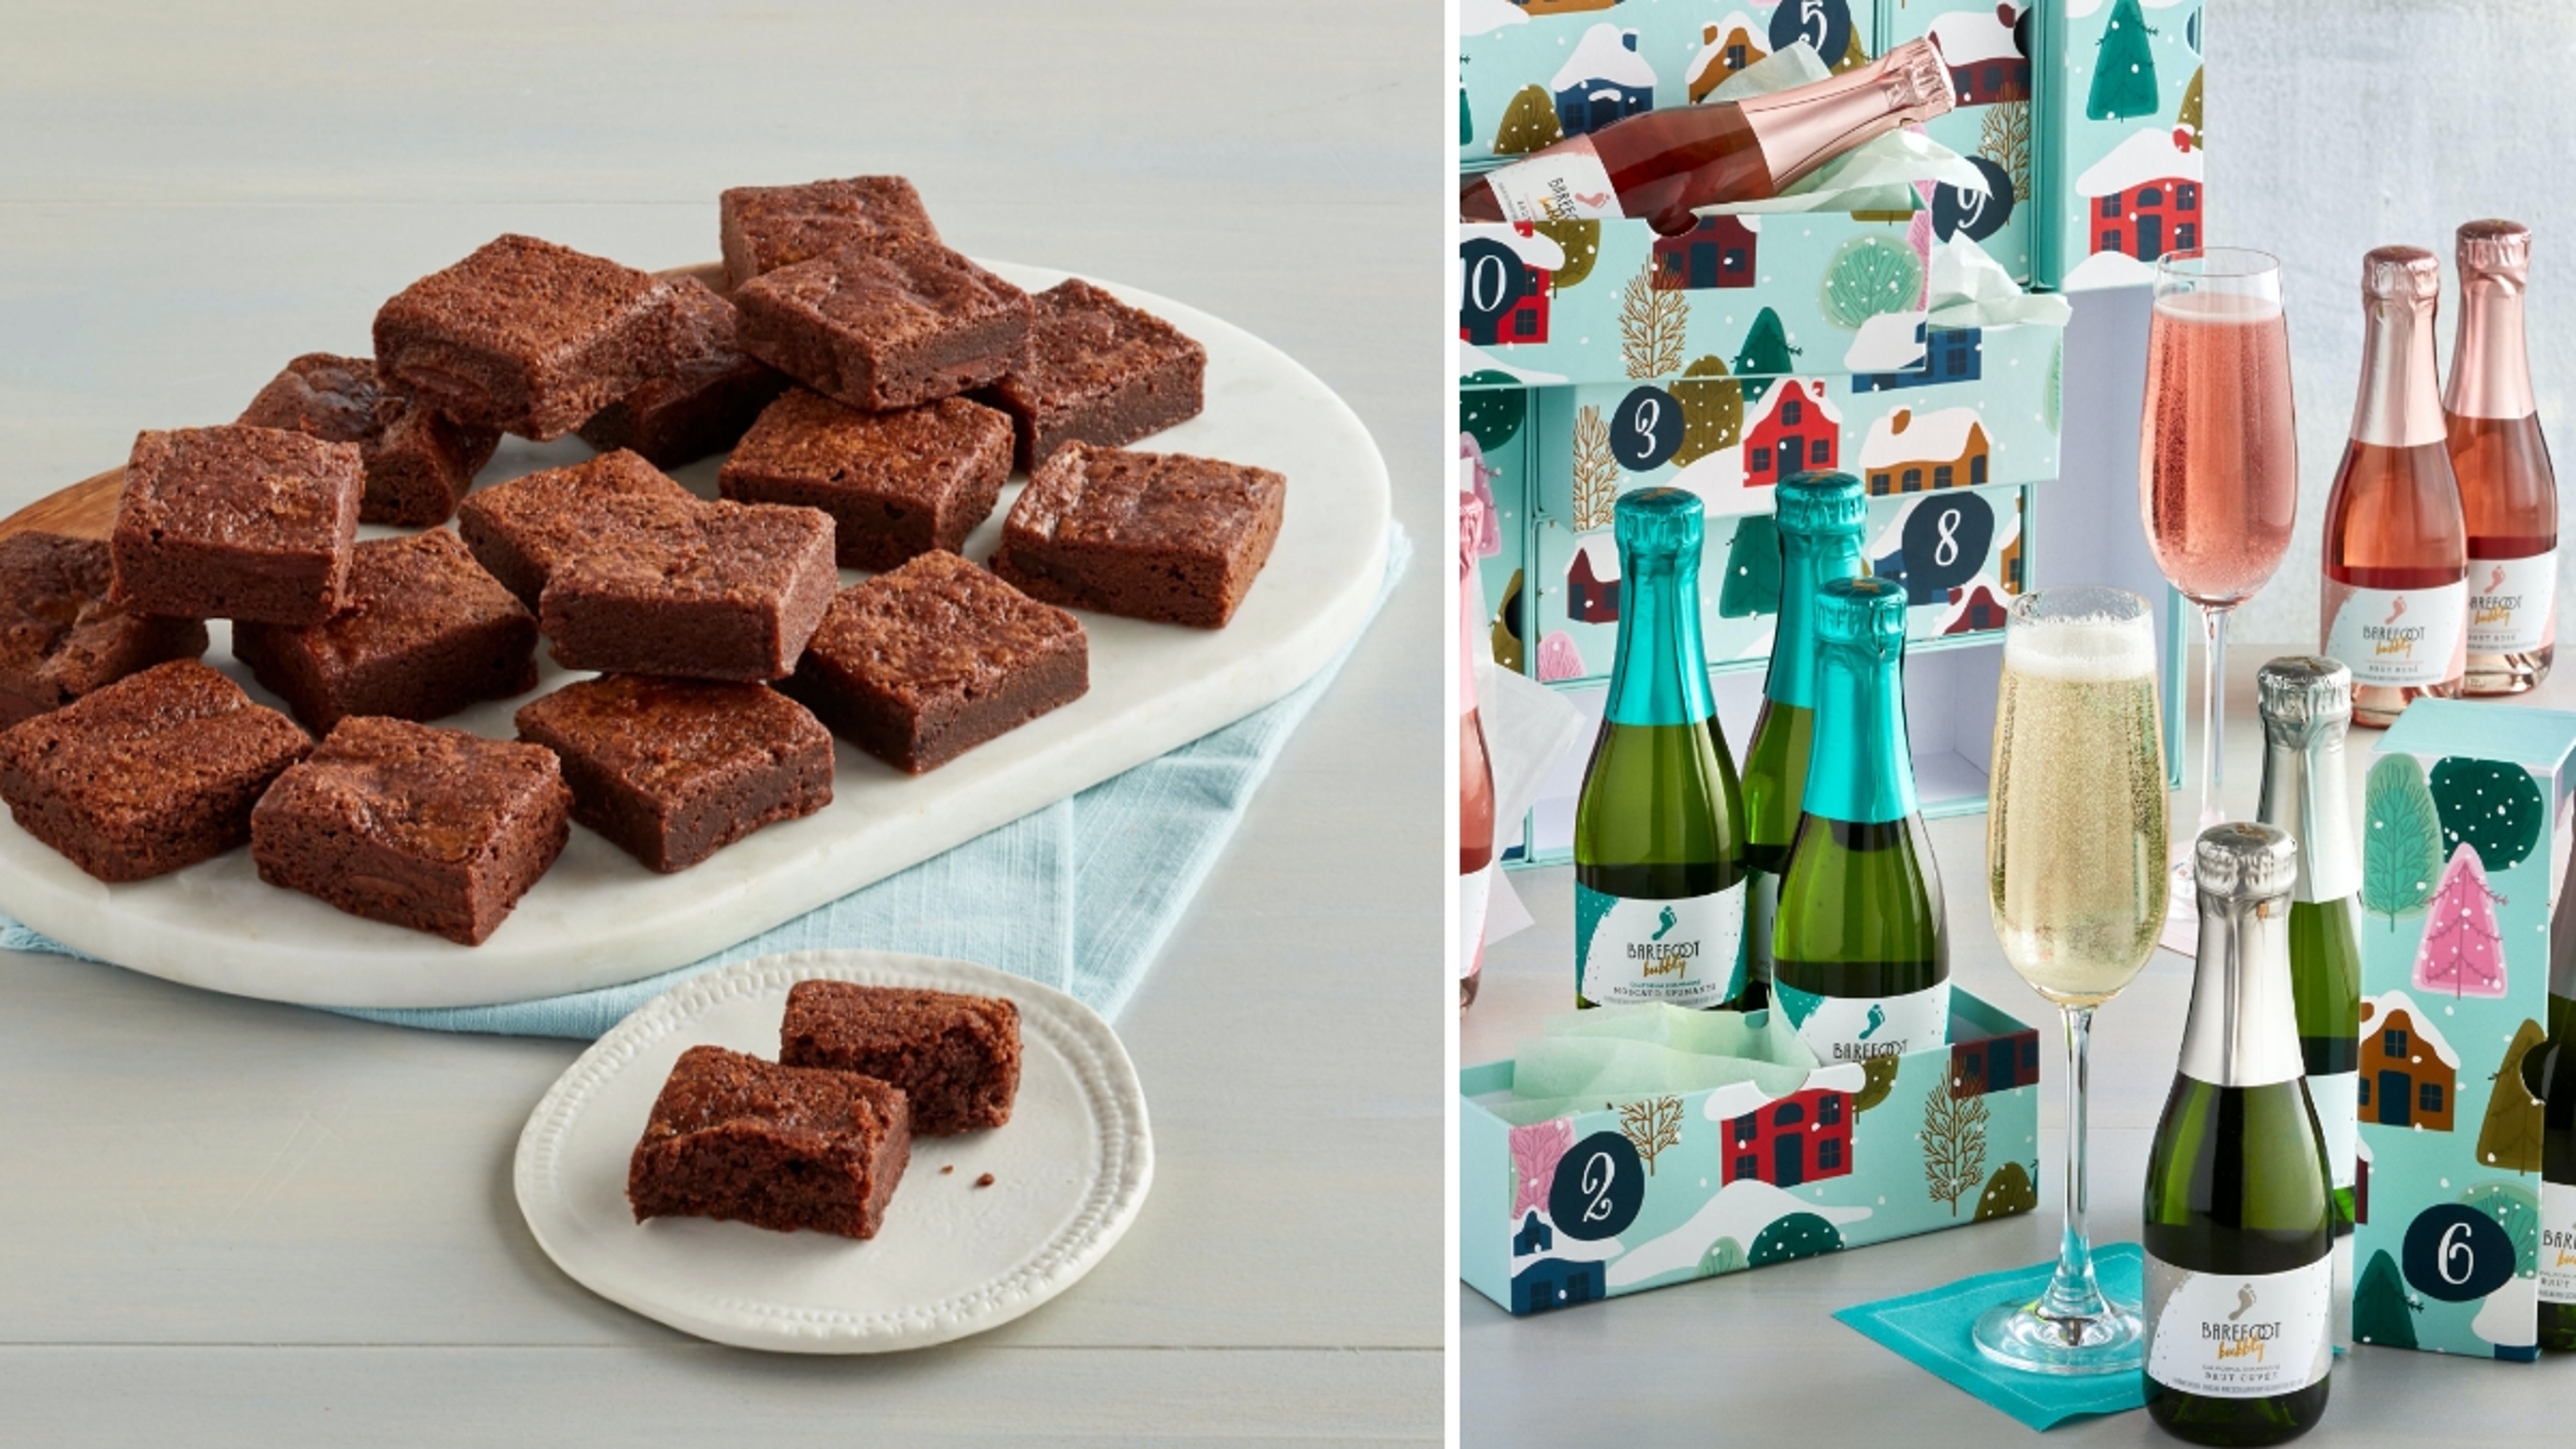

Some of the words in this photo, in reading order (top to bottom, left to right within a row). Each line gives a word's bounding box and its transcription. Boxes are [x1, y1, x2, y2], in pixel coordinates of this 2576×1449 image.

[1800, 0, 1827, 53] 5
[1635, 398, 1660, 459] 3
[1935, 508, 1961, 566] 8
[2469, 595, 2522, 610] AREFOOT
[2363, 625, 2426, 641] BAREFOOT
[1626, 941, 1701, 960] BAREFOOT
[1643, 953, 1686, 979] bubbly
[1833, 1039, 1908, 1059] BAREFOOT
[1582, 1152, 1615, 1222] 2
[2438, 1223, 2473, 1284] 6
[2202, 1322, 2282, 1341] BAREFOOT
[2218, 1335, 2265, 1362] bubbly
